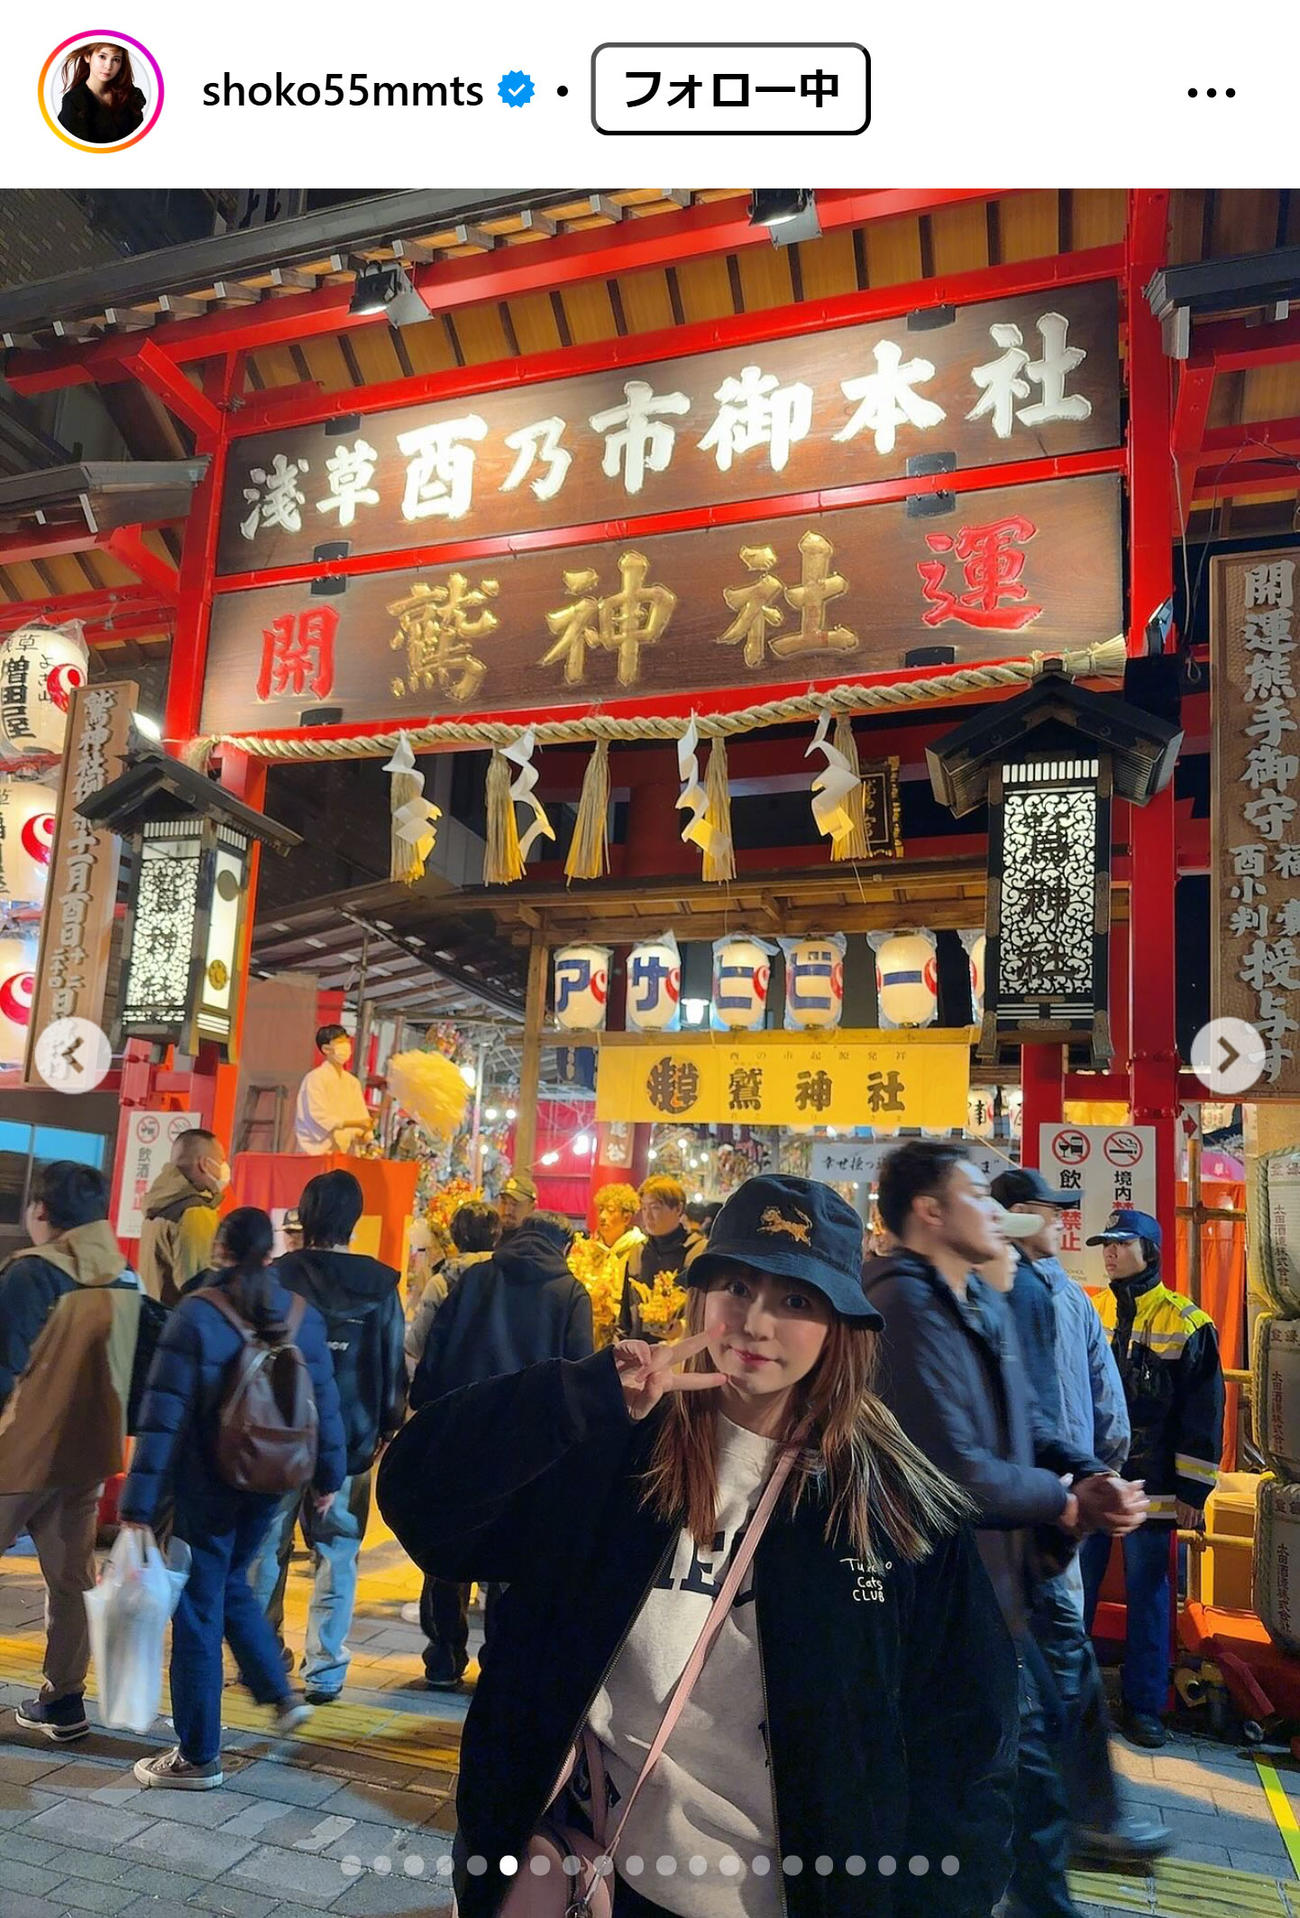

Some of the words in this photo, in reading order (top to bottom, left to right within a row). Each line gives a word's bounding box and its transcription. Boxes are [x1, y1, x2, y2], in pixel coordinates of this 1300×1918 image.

[256, 605, 339, 701] 開
[386, 530, 860, 701] 鷲神社
[917, 514, 1044, 631] 運
[728, 1068, 906, 1111] 鷲神社
[1060, 1169, 1082, 1252] 飲禁止
[852, 1589, 885, 1603] CLUB
[857, 1576, 883, 1590] Cats
